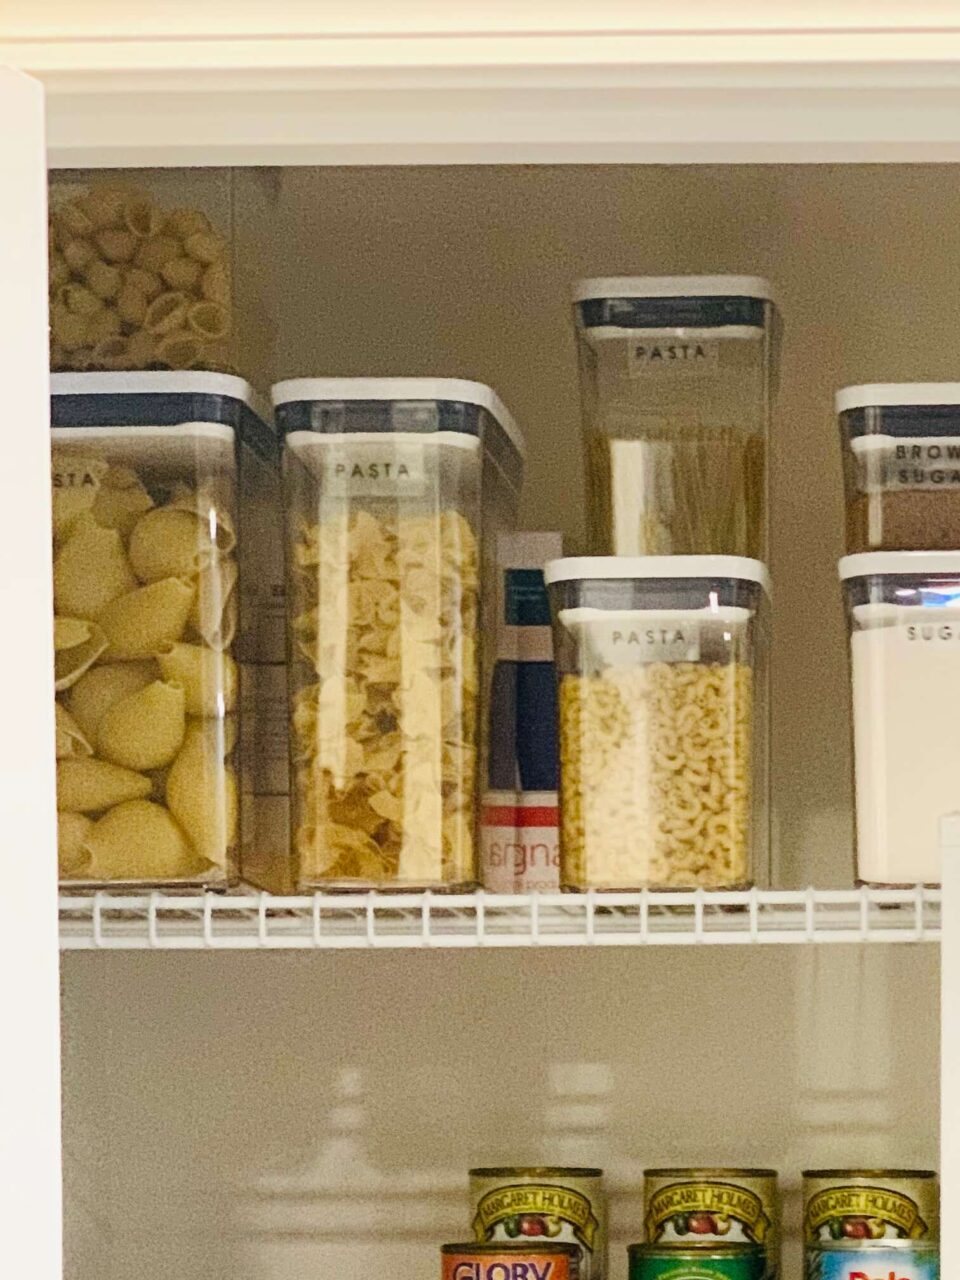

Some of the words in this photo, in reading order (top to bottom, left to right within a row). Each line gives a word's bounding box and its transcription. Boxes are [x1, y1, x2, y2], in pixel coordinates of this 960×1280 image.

[635, 345, 707, 360] PASTA
[335, 463, 410, 477] PASTA
[52, 473, 95, 487] STA
[613, 631, 685, 644] PASTA
